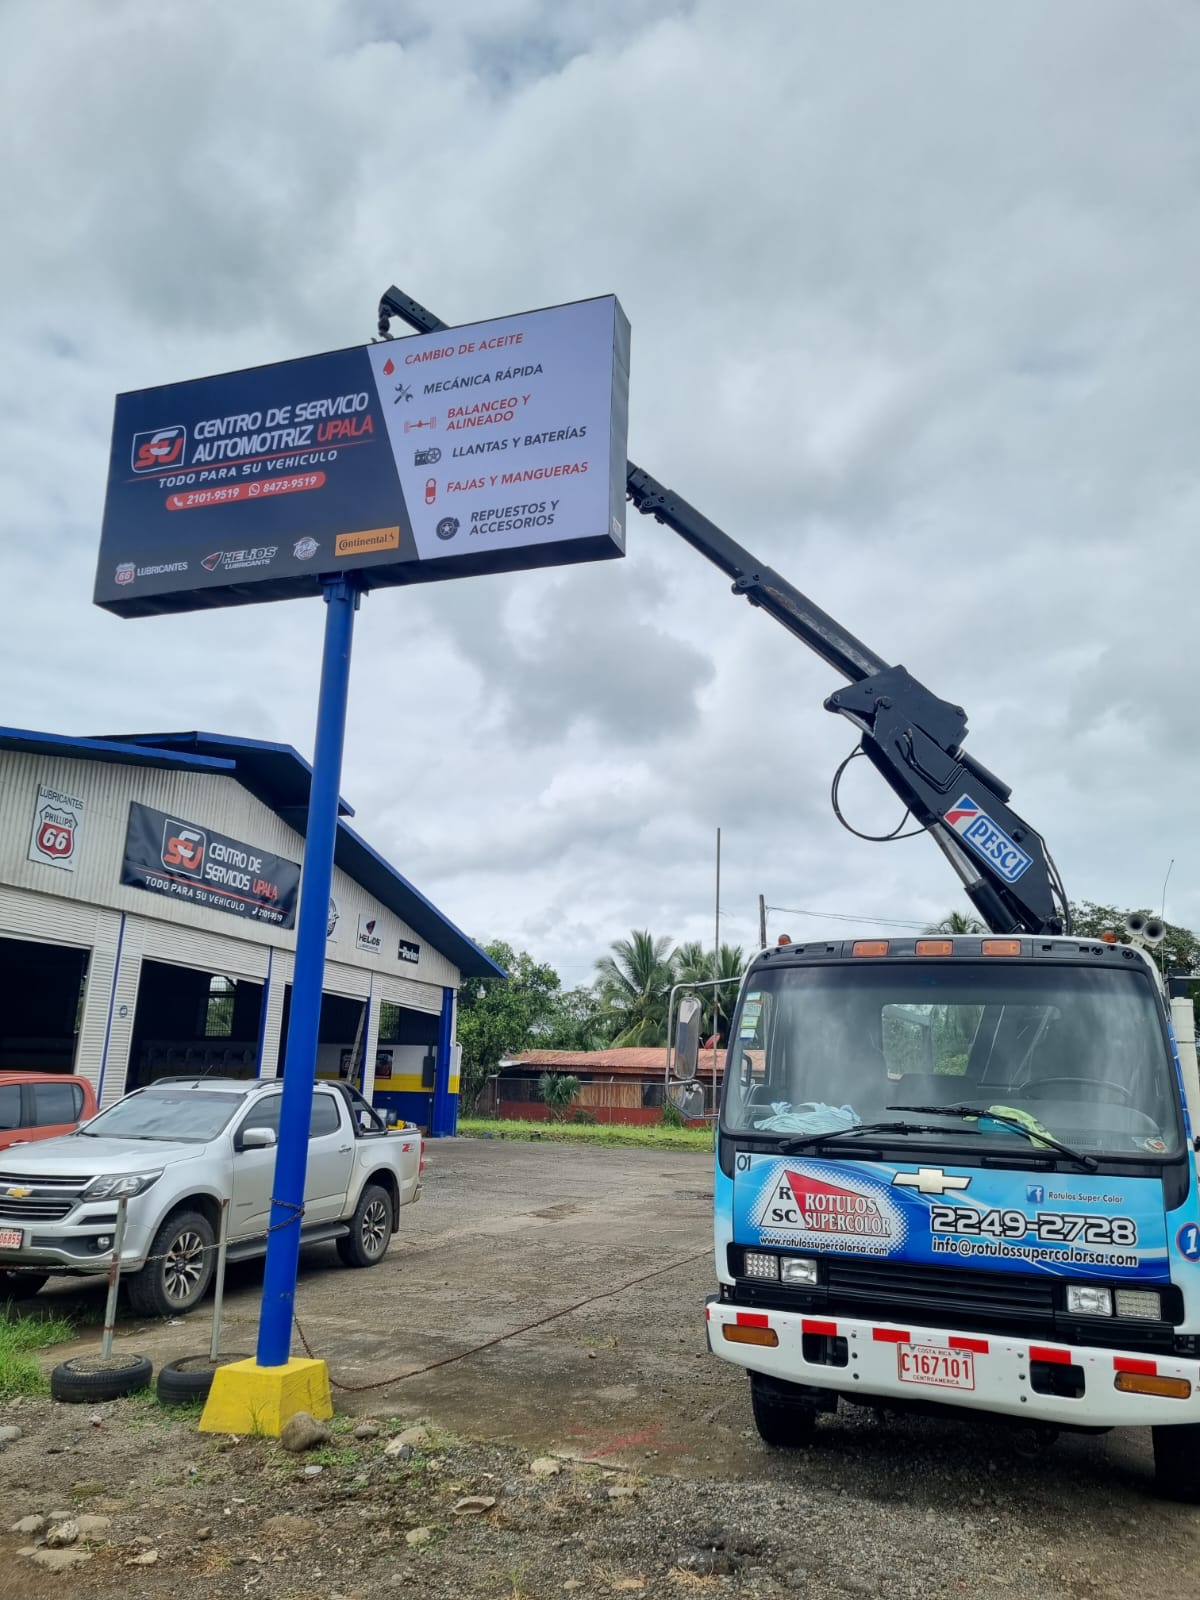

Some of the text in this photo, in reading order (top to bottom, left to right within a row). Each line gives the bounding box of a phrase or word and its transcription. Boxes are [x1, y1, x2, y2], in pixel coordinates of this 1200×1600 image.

[404, 332, 524, 366] CAMBIO DE ACEITE
[423, 363, 544, 395] MECÁNICA RÁPIDA
[193, 392, 369, 440] CENTRO DE SERVICIO
[447, 394, 531, 420] BALANCEO Y
[446, 410, 513, 431] ALINEADO
[192, 414, 374, 464] AUTOMOTRIZ UPALA
[452, 426, 587, 458] LLANTAS Y BATERÍAS
[159, 473, 196, 489] TODO
[199, 466, 237, 482] PARA
[241, 461, 262, 475] SU
[263, 476, 317, 493] 8473-9519
[447, 461, 589, 493] FAJAS Y MANGUERAS
[470, 499, 560, 522] REPUESTOS Y
[469, 514, 555, 535] ACCESORIOS
[338, 534, 388, 551] Continental
[118, 571, 131, 581] 66
[136, 561, 189, 576] LUBRICANTES
[40, 787, 84, 810] LUBRICANTES
[44, 812, 73, 829] PHILLIPS
[42, 828, 68, 850] 66
[969, 820, 1025, 876] PESCI
[208, 842, 263, 874] CENTRO DE
[145, 875, 169, 890] TODO
[170, 883, 194, 898] PARA
[195, 890, 207, 901] SU
[204, 863, 278, 900] SERVICIOS UPALA
[736, 1154, 751, 1171] 01
[779, 1186, 791, 1200] R
[804, 1193, 878, 1215] ROTULOS
[1048, 1191, 1123, 1204] Rotulos Super Color
[771, 1208, 798, 1223] SC
[803, 1211, 891, 1236] SUPERCOLOR
[931, 1205, 1137, 1247] 2249-2728
[760, 1236, 889, 1257] www.rotulossupercolorsa.com
[932, 1238, 1138, 1267] info@rotulossupercolorsa.com
[917, 1347, 952, 1357] COSTA RICA
[901, 1352, 970, 1380] C167101
[913, 1374, 960, 1385] CENTROAMERICA
